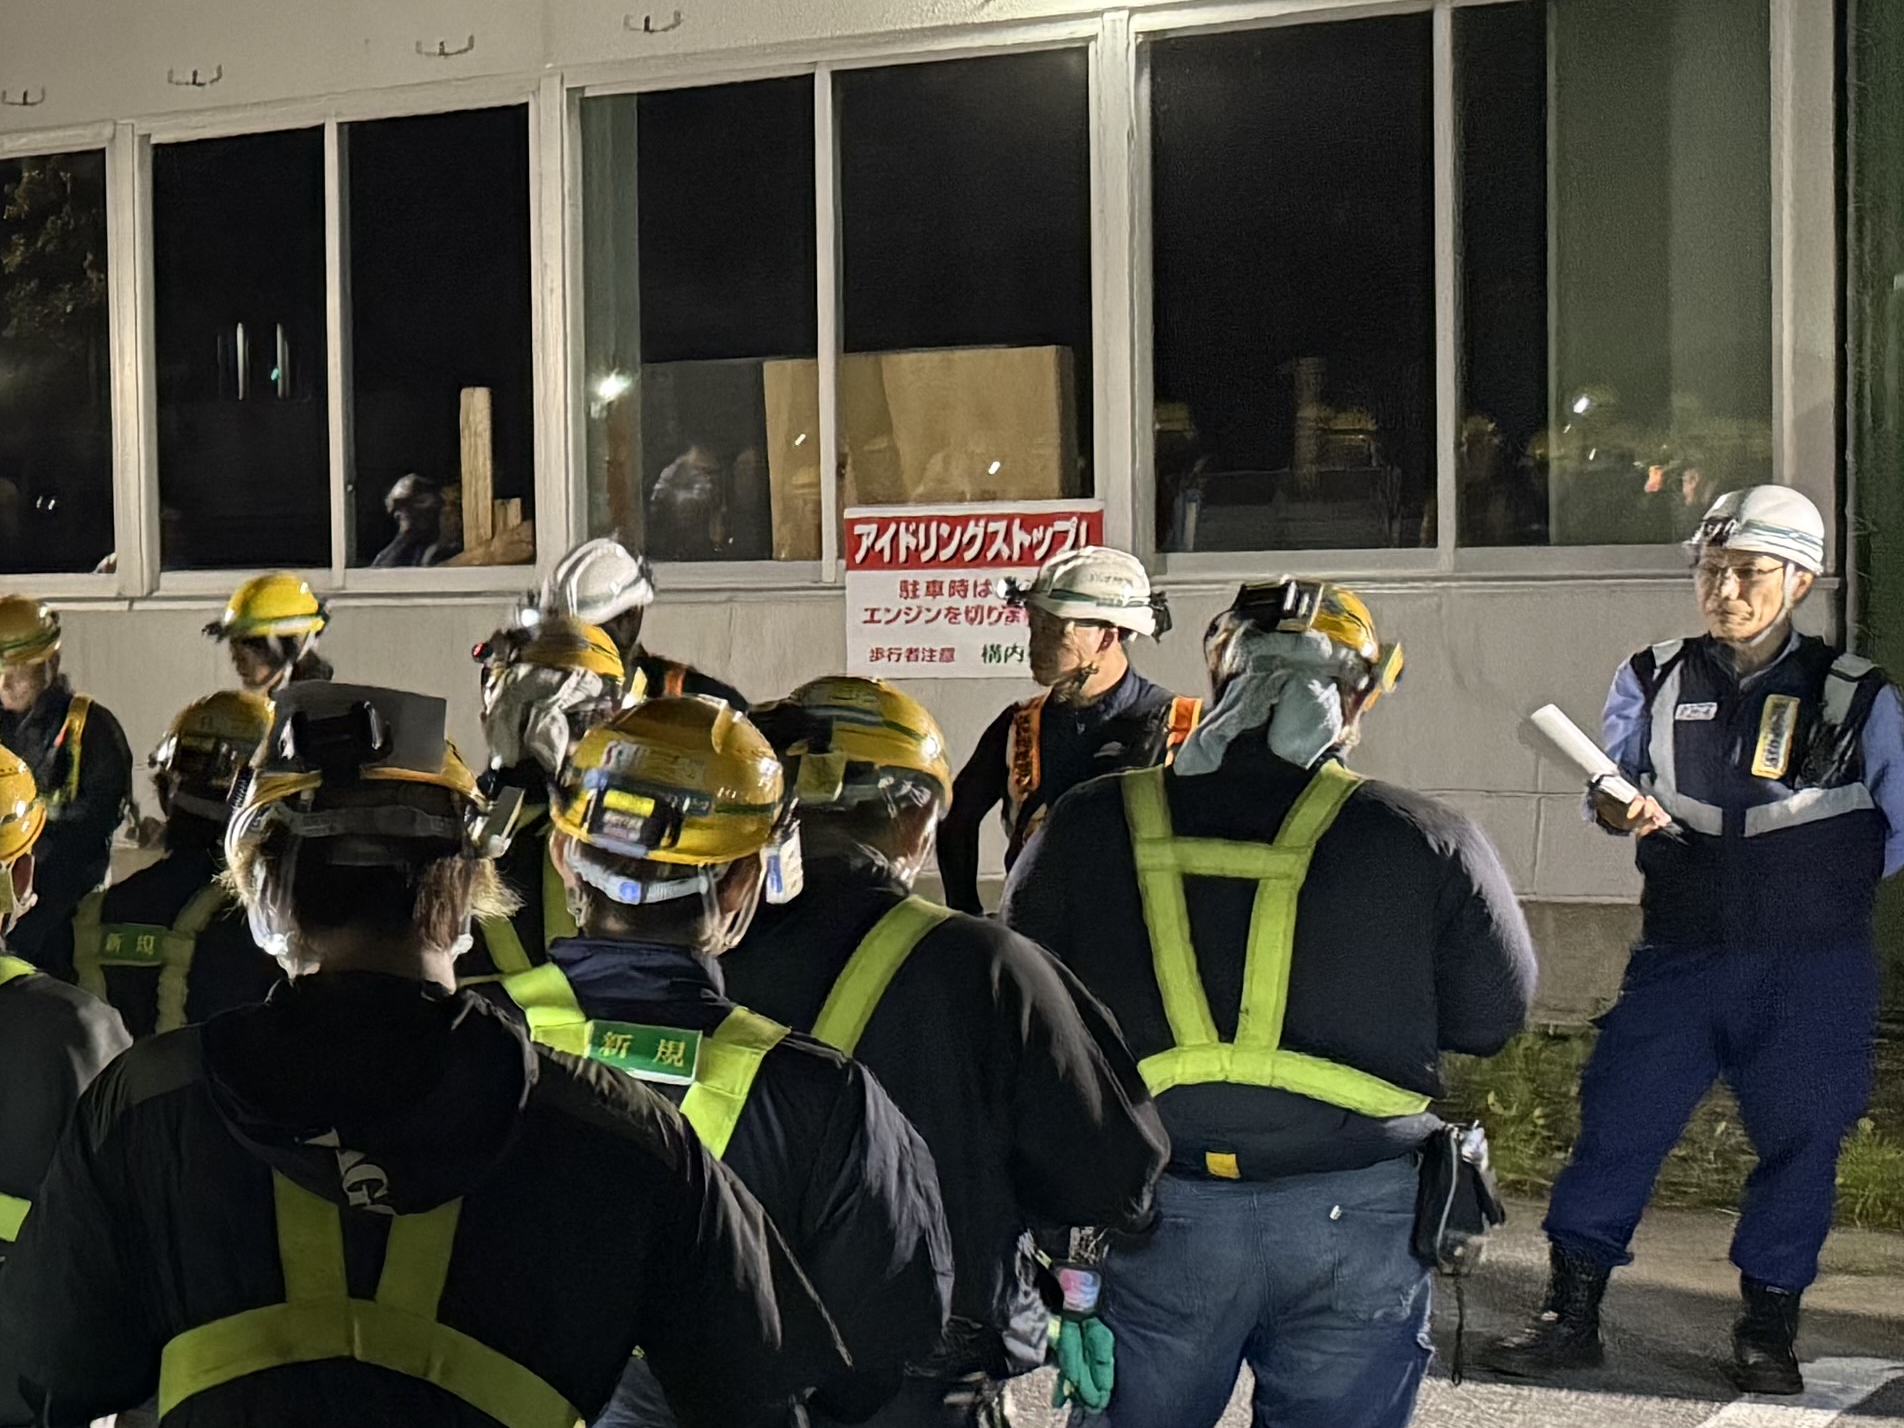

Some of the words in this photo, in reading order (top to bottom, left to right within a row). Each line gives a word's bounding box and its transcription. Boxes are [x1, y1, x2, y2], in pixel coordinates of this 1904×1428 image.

[898, 578, 993, 599] 駐車時は
[869, 646, 956, 664] 歩行者注意
[599, 1031, 685, 1068] 新規
